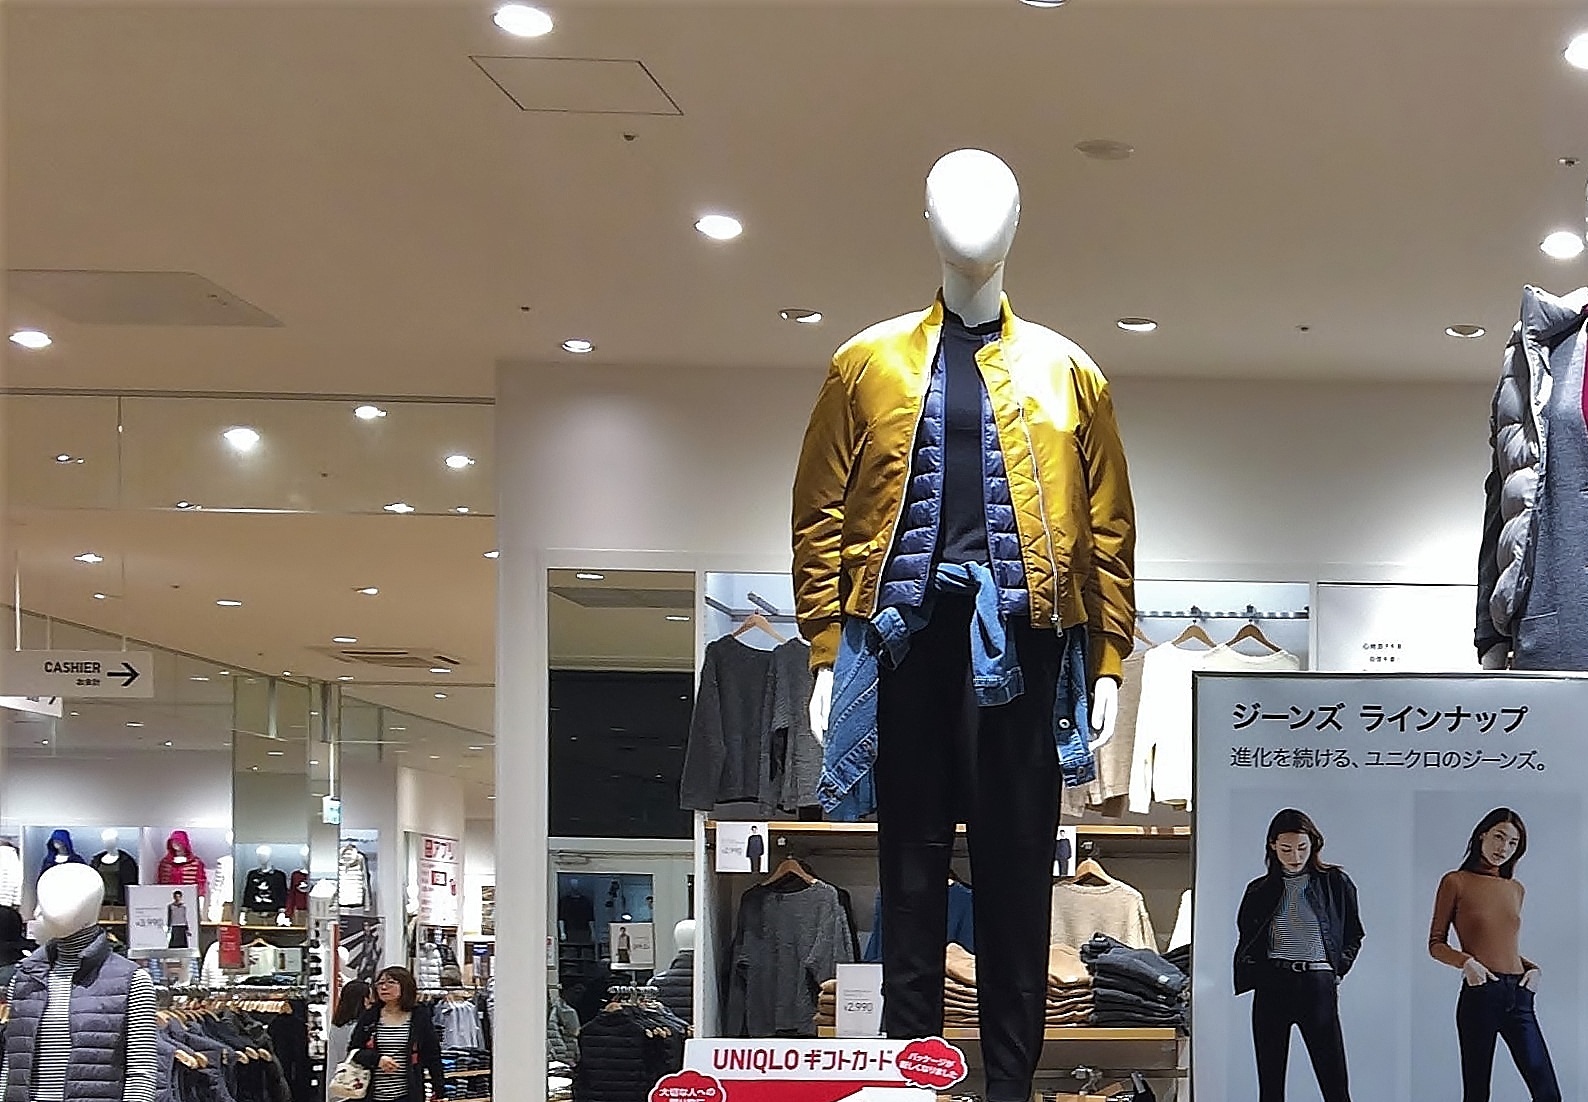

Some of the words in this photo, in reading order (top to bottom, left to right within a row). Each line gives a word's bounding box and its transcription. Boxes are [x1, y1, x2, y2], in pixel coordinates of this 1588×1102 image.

[44, 661, 101, 674] CASHIER
[1232, 702, 1346, 732] ジーンズ
[1359, 704, 1529, 733] ラインナップ
[1230, 747, 1547, 772] 進化を続ける、ユニクロのジーンズ。
[713, 1048, 800, 1073] UNIQLO
[804, 1048, 893, 1071] ギフトカード
[659, 1087, 716, 1097] 大切な人への
